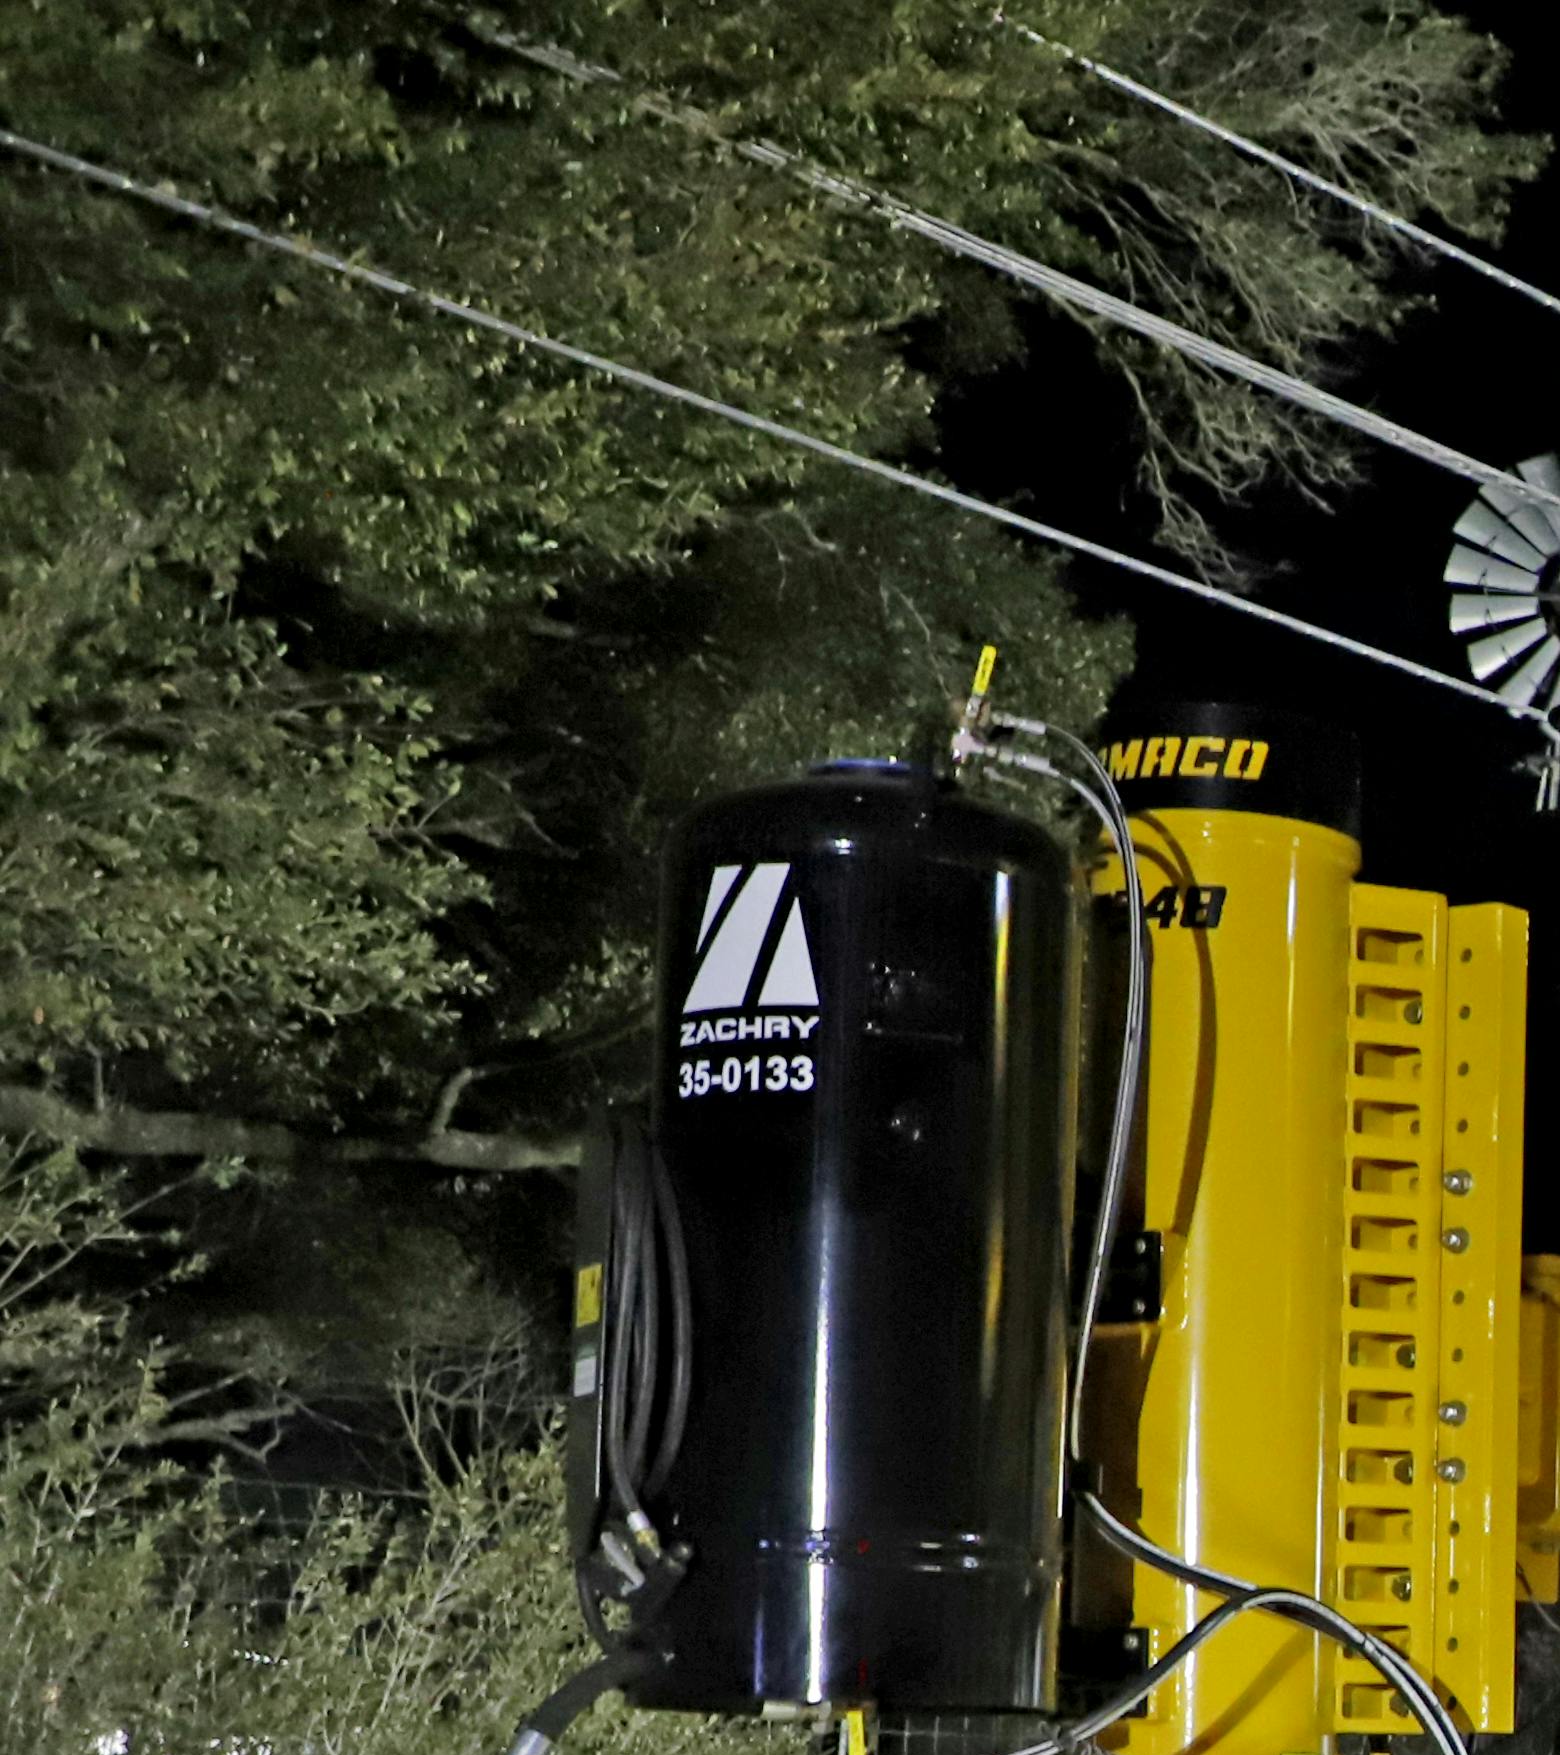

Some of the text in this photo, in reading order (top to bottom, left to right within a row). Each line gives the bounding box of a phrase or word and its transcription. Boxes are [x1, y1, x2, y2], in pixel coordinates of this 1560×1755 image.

[1097, 735, 1270, 782] MACO
[679, 1015, 821, 1048] ZACHRY
[678, 1055, 815, 1098] 35-0133
